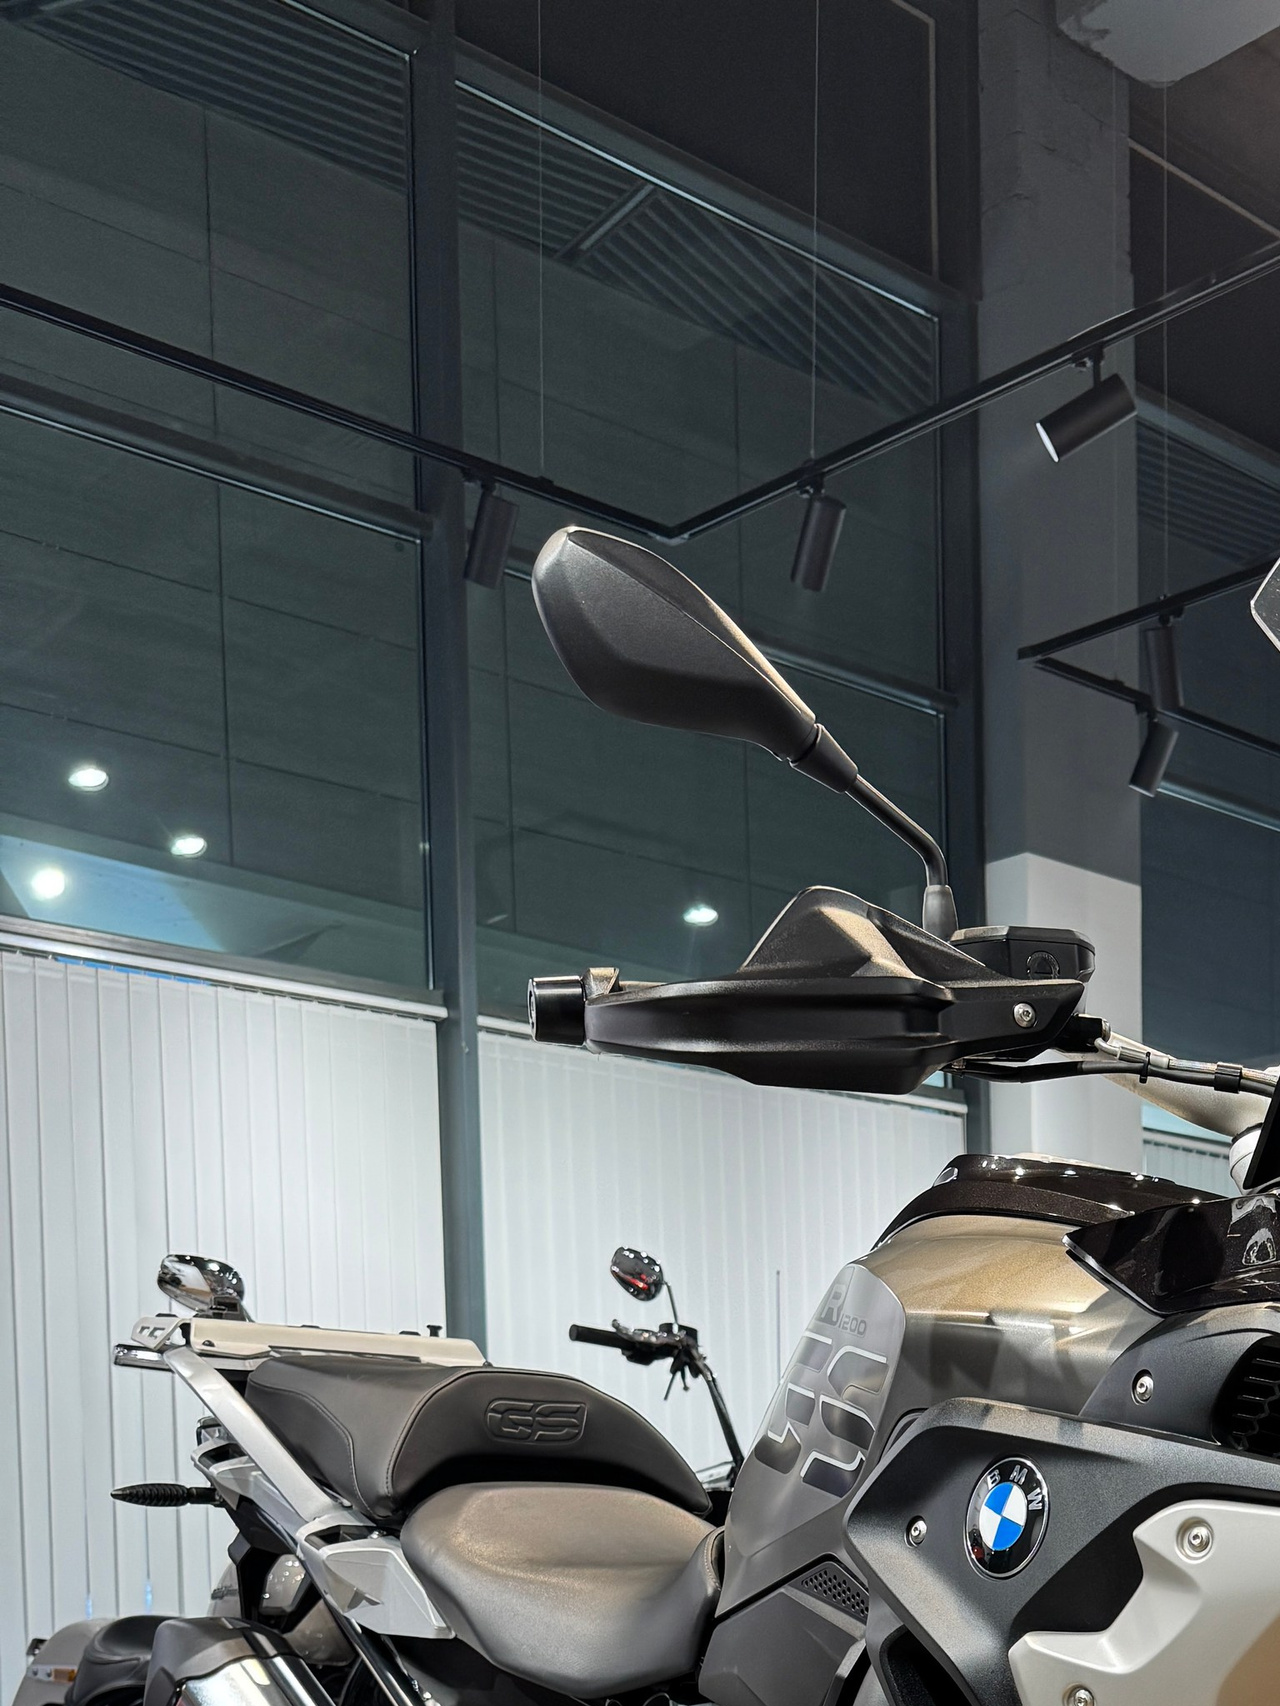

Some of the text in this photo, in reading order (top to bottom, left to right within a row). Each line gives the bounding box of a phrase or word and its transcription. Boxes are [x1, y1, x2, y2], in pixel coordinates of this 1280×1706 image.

[838, 1312, 868, 1336] 1200
[486, 1400, 582, 1441] GS
[986, 1464, 1043, 1511] BMW
